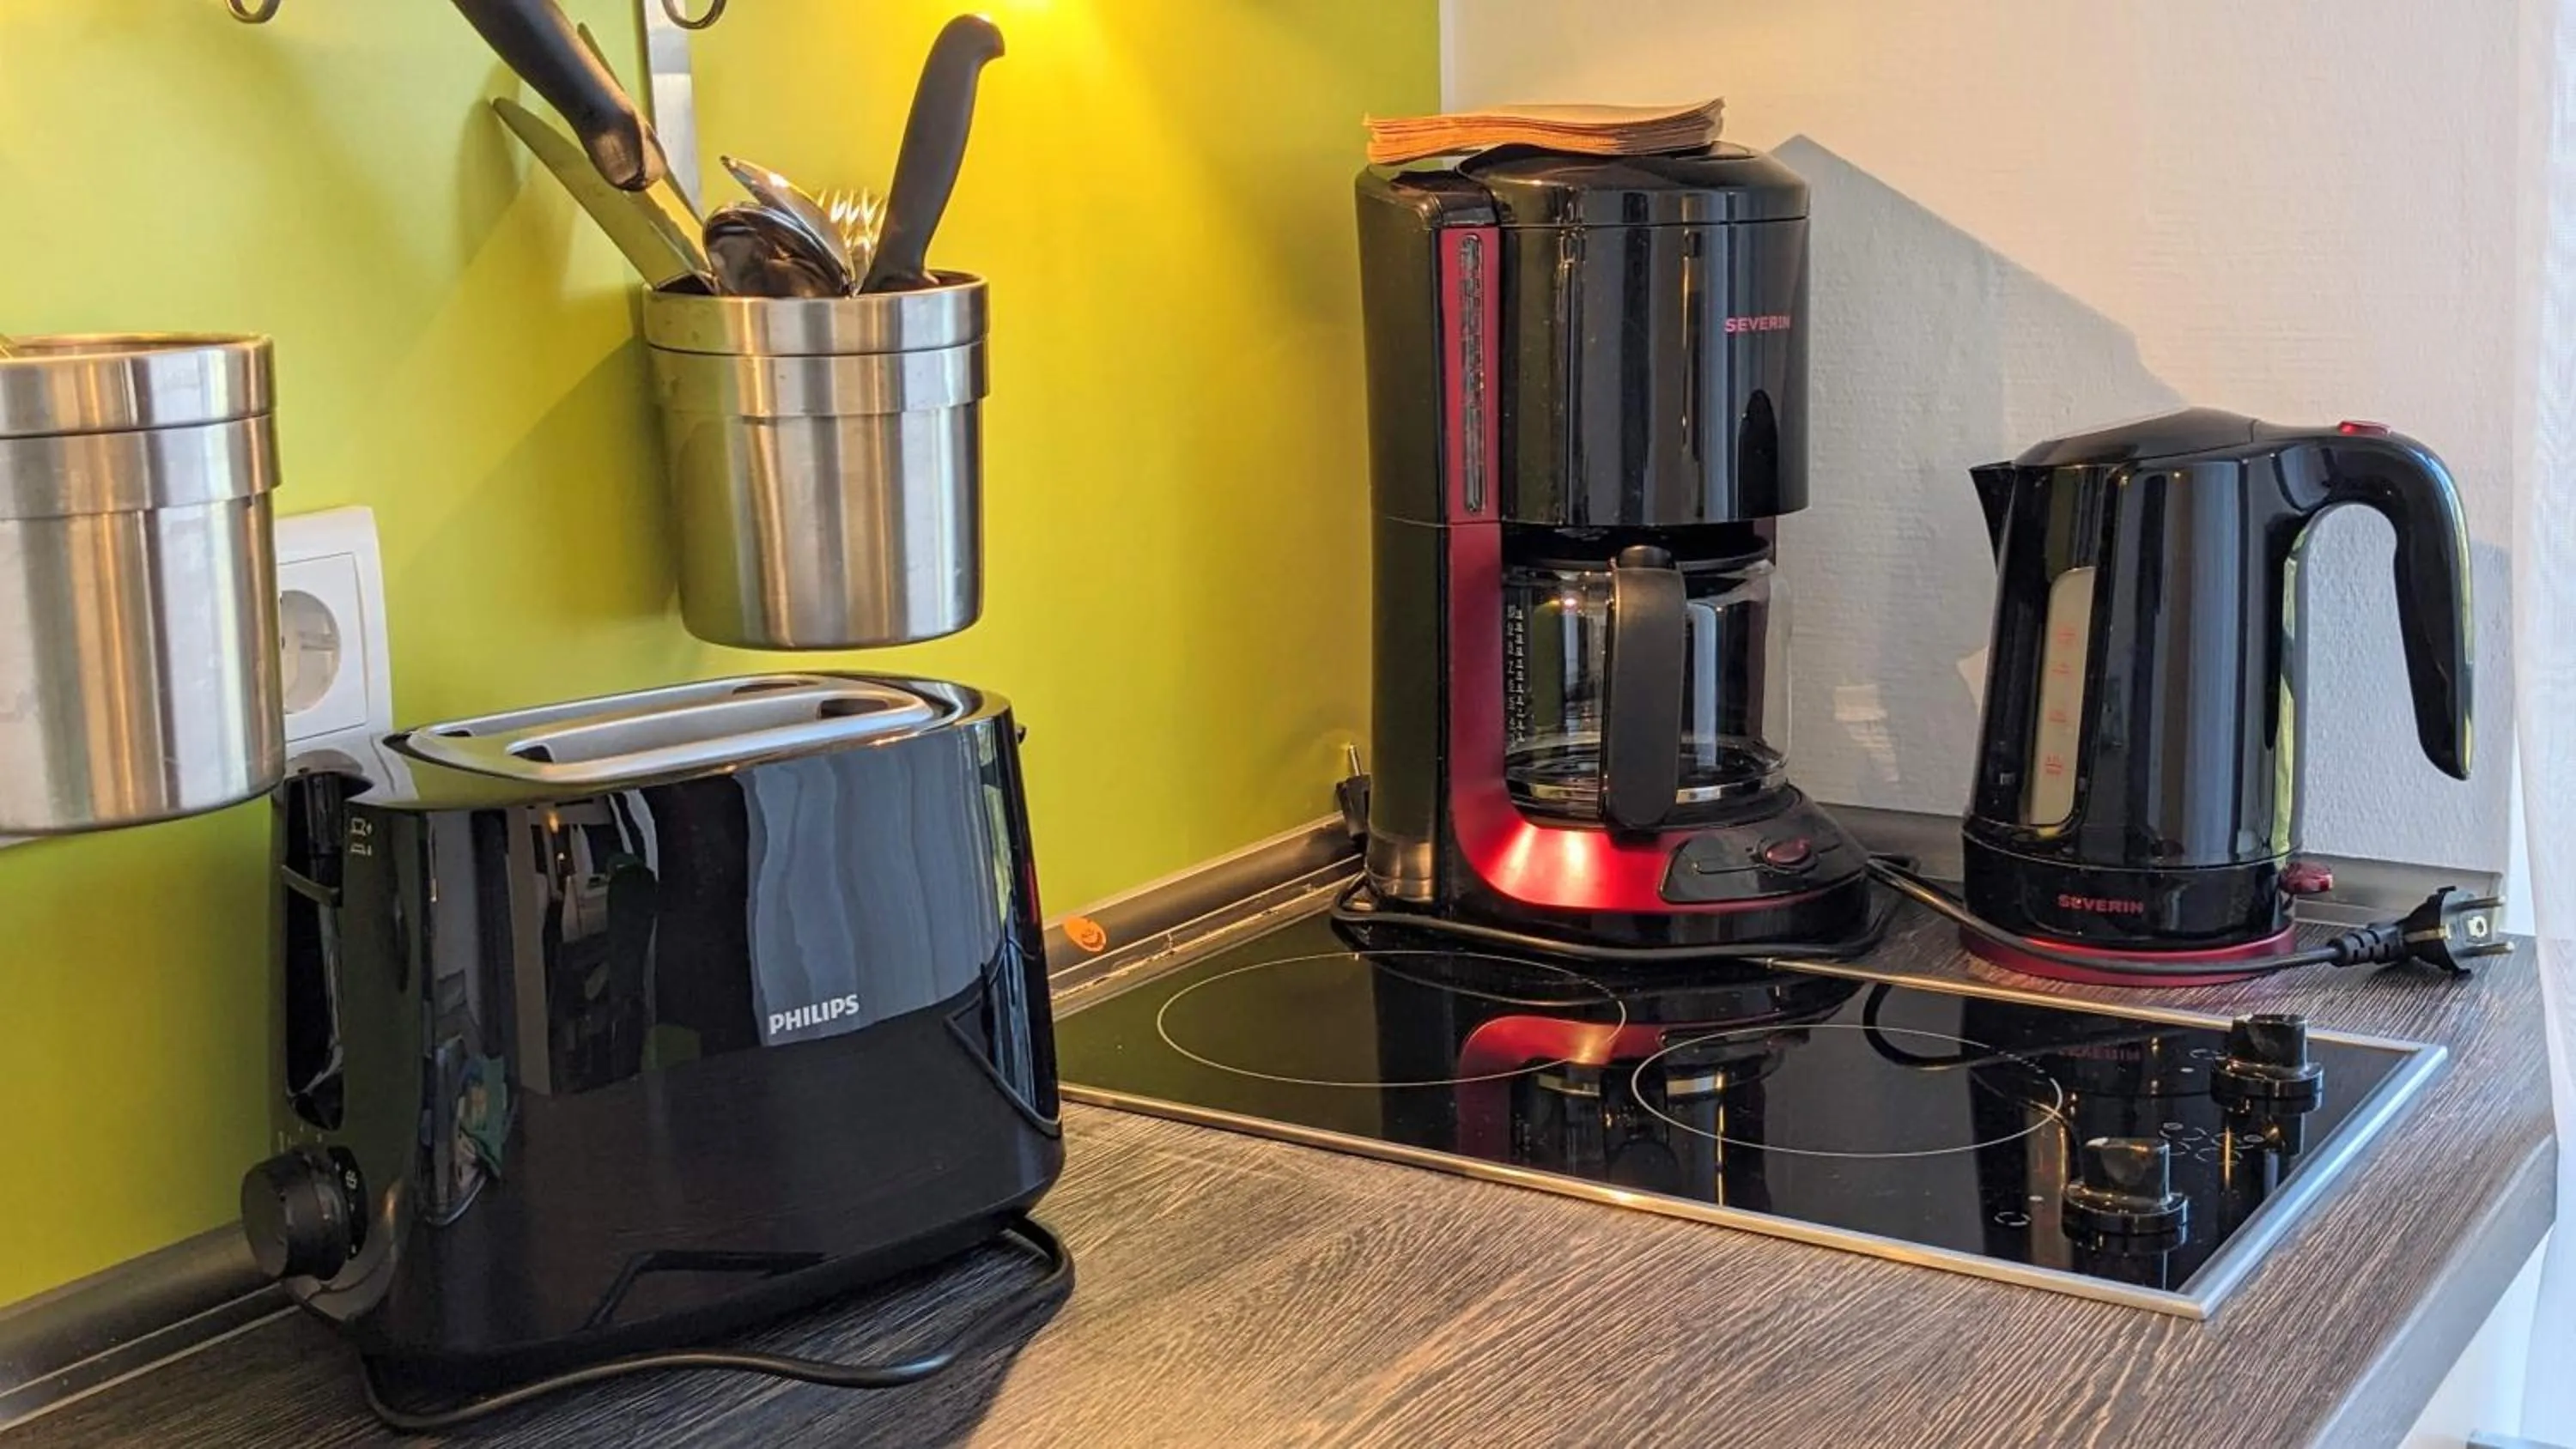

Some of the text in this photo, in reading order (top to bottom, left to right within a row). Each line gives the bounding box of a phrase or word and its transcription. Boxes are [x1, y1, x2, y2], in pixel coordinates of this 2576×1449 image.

[1724, 314, 1791, 333] SEVERIN
[2057, 894, 2144, 914] SEVERIN
[769, 994, 860, 1035] PHILIPS
